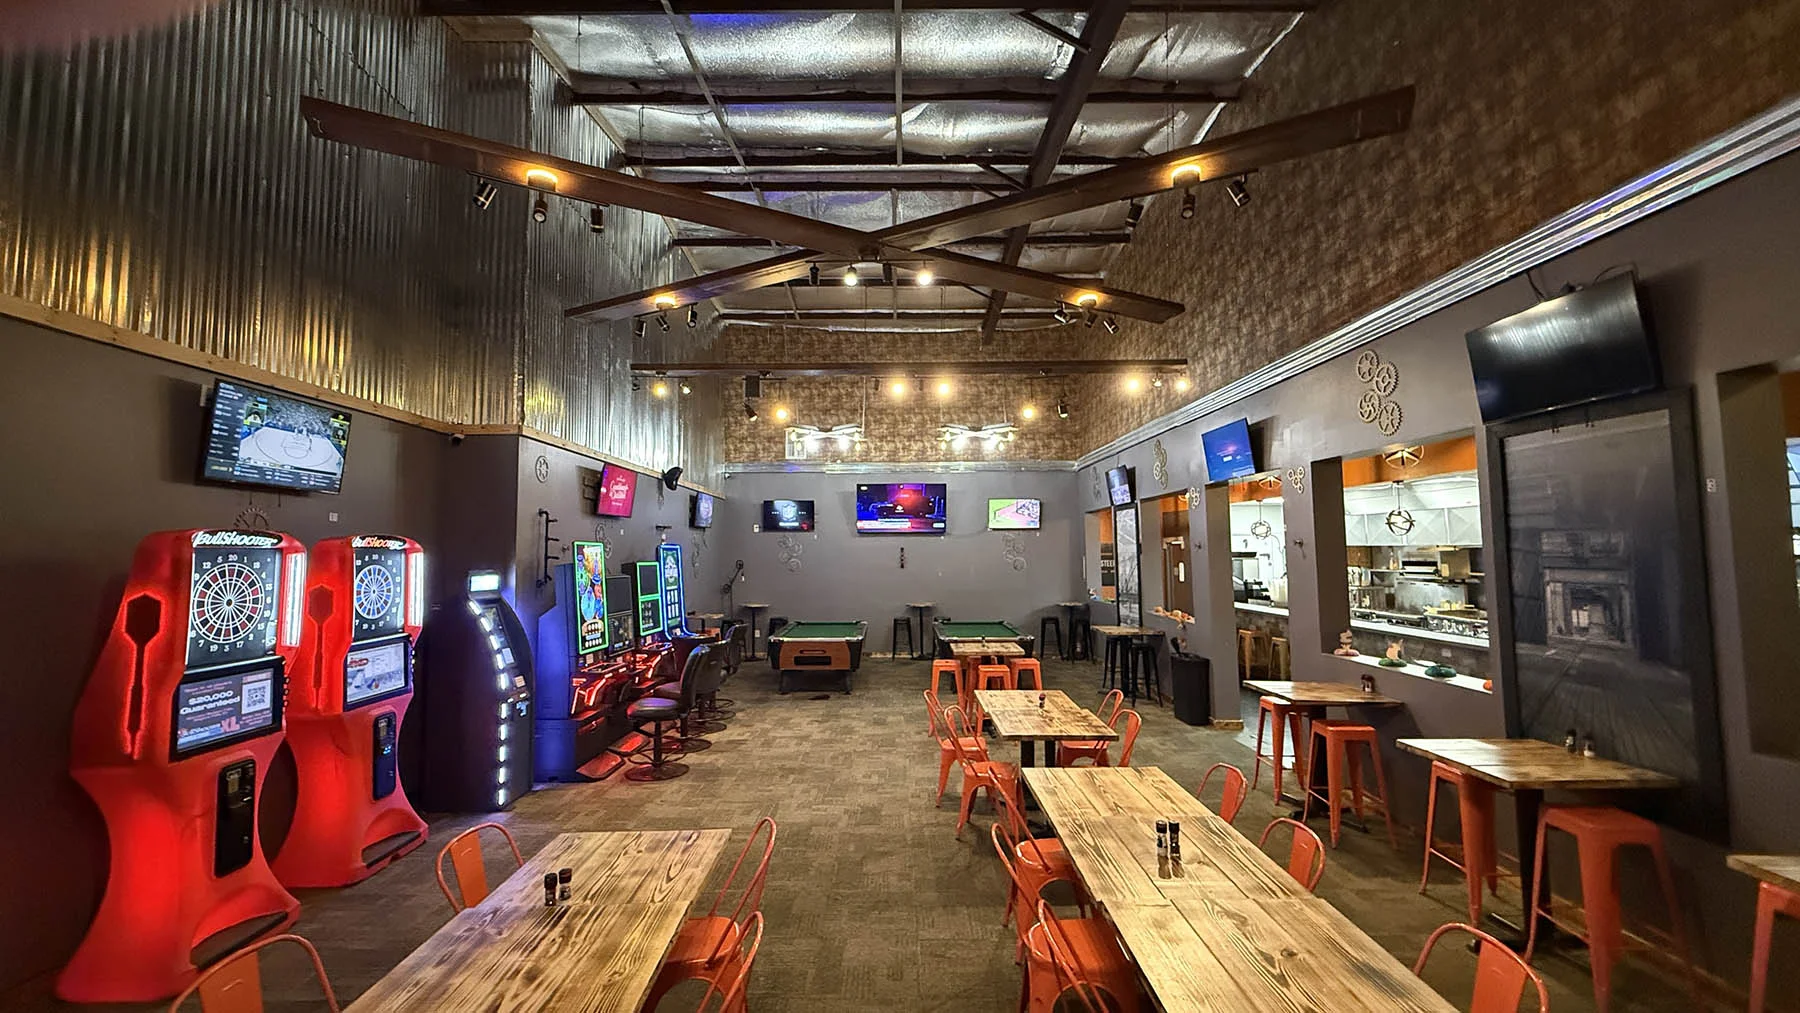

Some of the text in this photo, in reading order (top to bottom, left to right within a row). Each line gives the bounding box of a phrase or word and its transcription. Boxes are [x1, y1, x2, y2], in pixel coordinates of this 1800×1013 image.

[198, 640, 205, 648] 7
[209, 644, 219, 652] 19
[236, 641, 244, 649] 17
[188, 690, 233, 705] $20,000
[180, 695, 241, 715] Guaranteed
